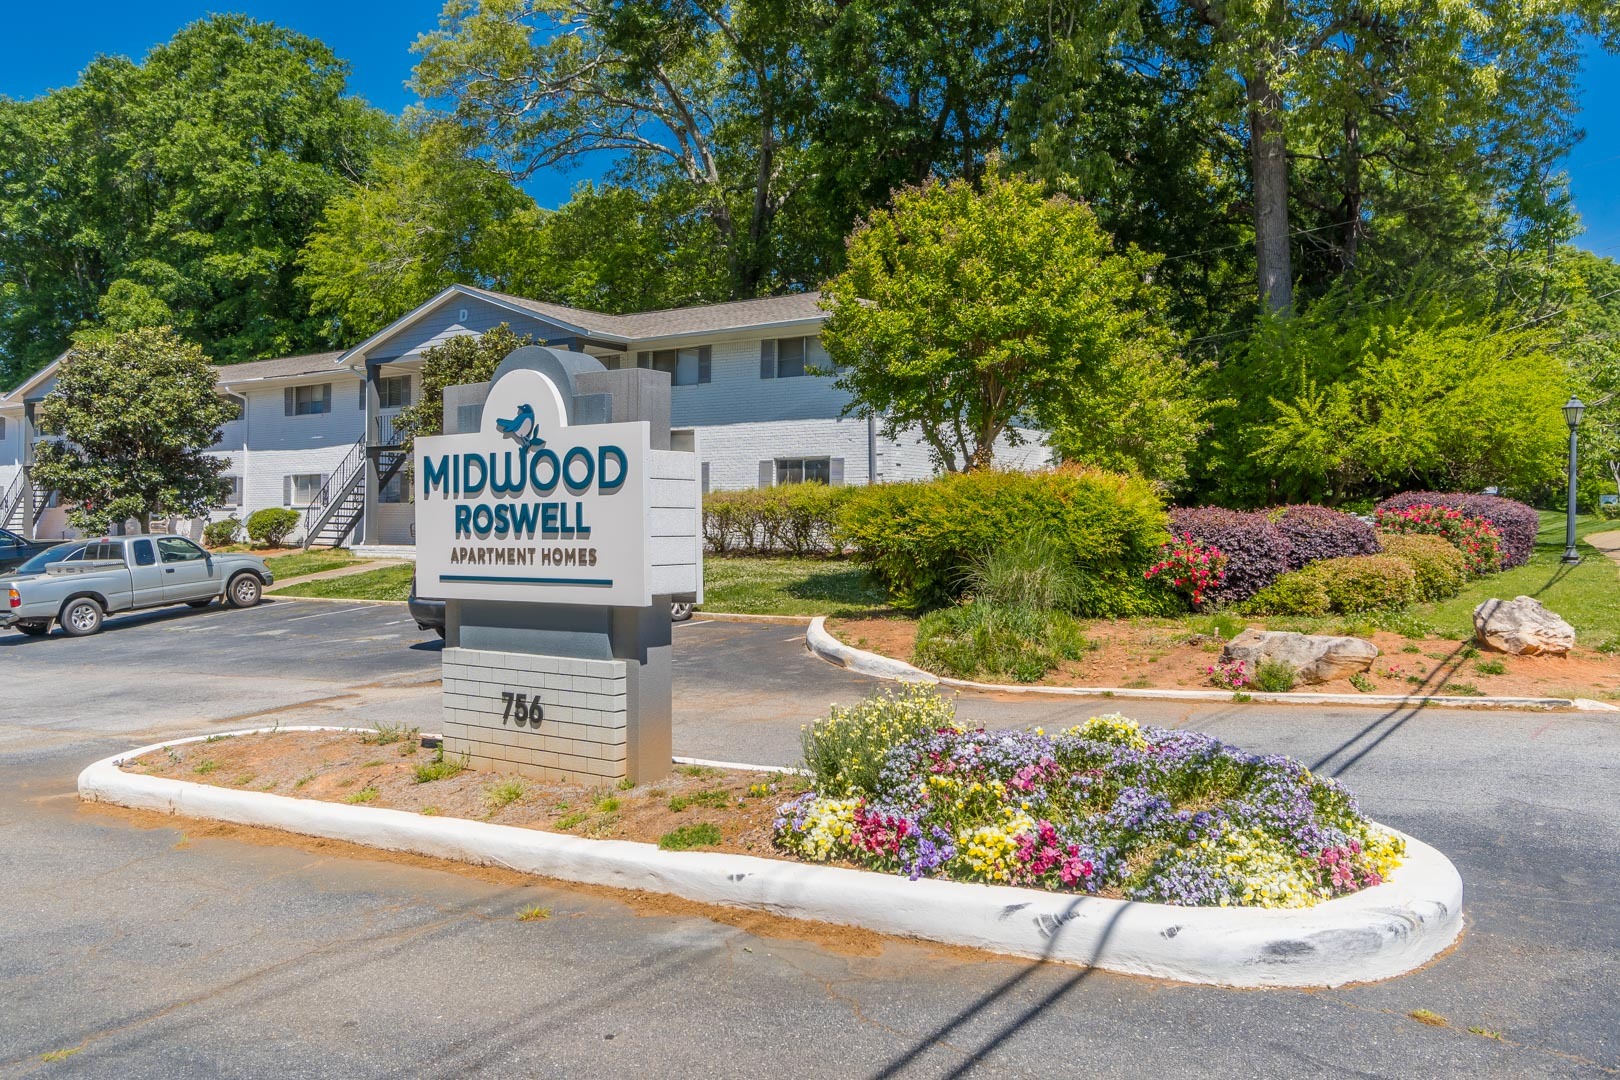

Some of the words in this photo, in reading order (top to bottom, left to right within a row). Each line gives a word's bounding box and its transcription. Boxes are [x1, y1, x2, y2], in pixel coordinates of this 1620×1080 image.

[459, 309, 468, 322] D
[424, 445, 628, 496] MIDWOOD
[456, 502, 592, 535] ROSWELL
[450, 547, 536, 566] APARTMENT
[541, 548, 598, 567] HOMES
[501, 691, 544, 725] 756
